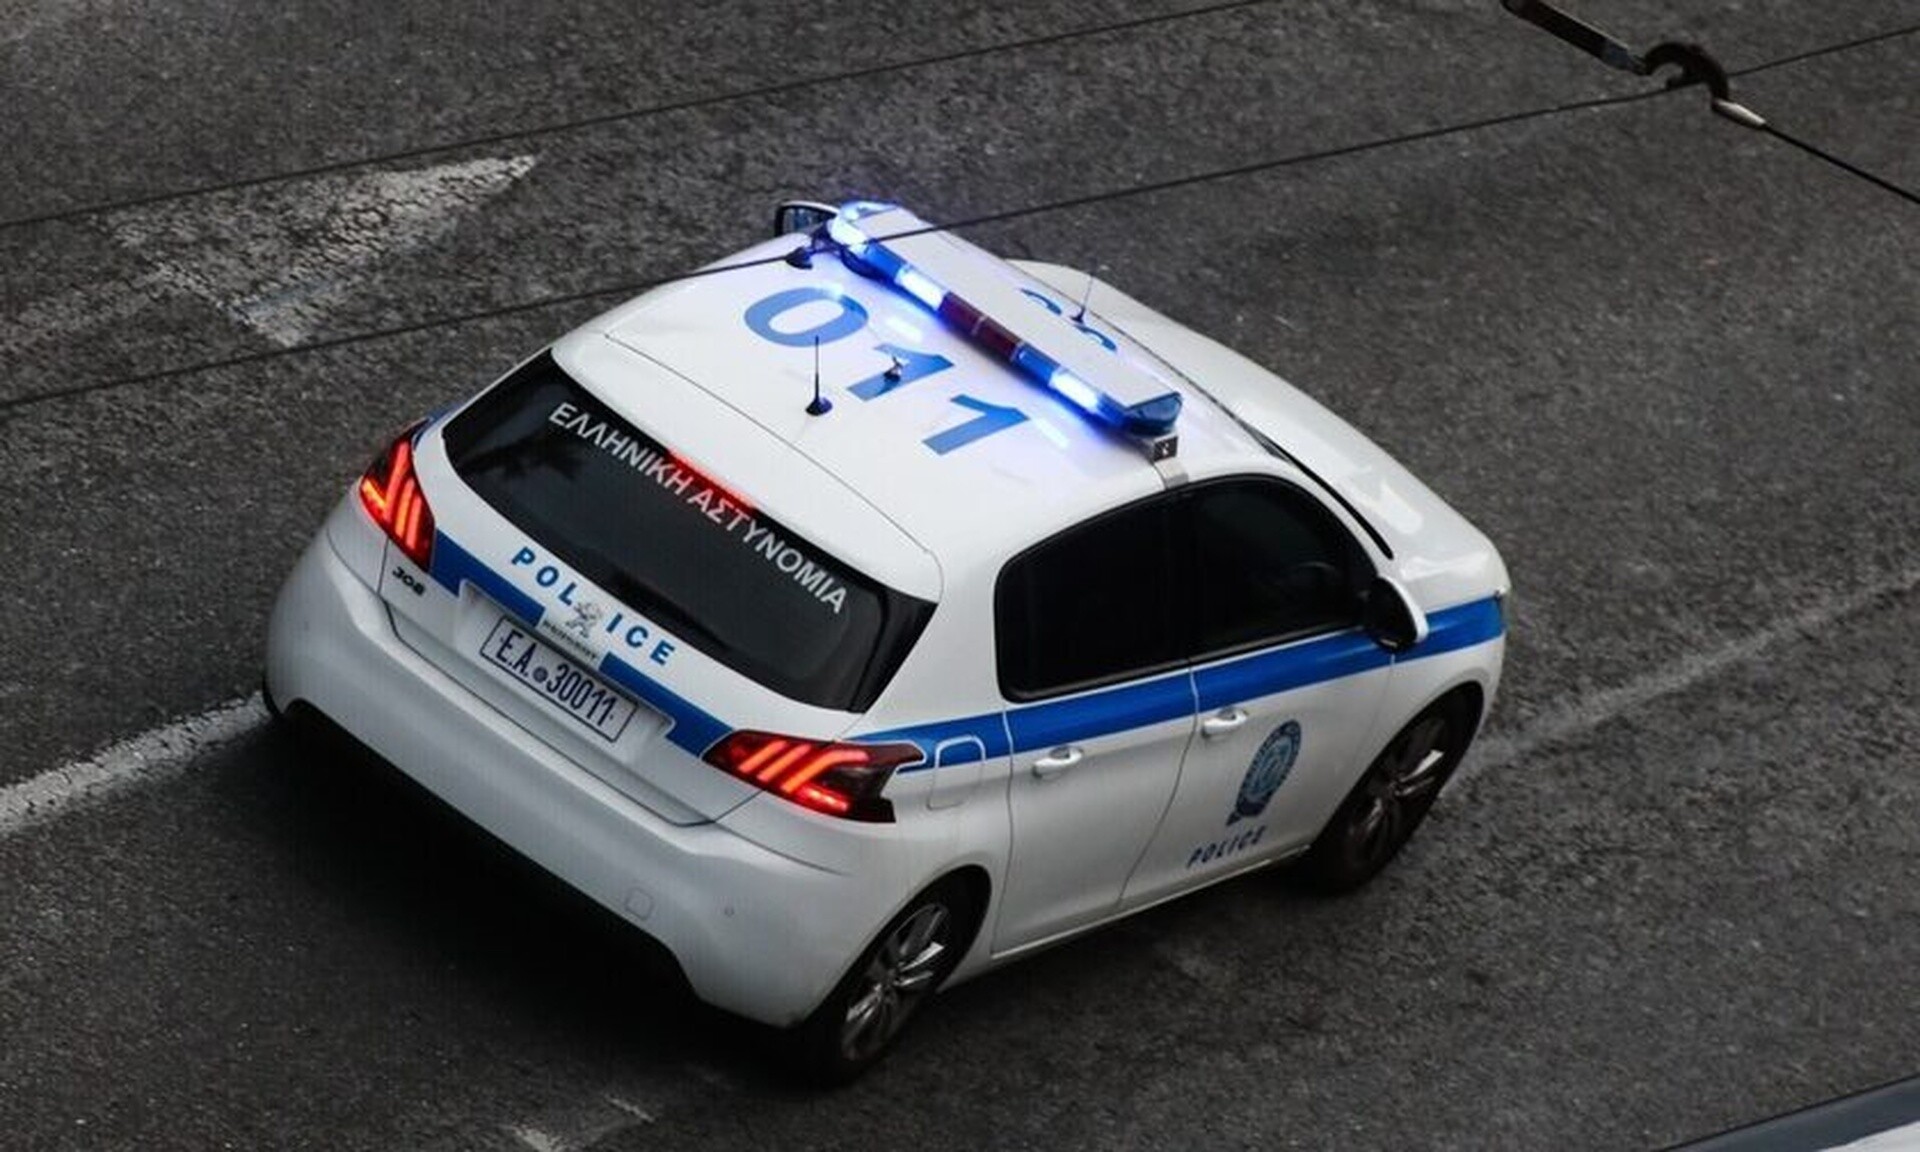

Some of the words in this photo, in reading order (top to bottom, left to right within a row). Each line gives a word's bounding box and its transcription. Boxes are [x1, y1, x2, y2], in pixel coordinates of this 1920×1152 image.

[744, 286, 1029, 455] 011
[392, 566, 425, 596] 308
[549, 402, 694, 492] ΕΛΛΗΝΙΚΗ
[687, 490, 848, 613] ΑΣΤΥΝΟΜΙΑ
